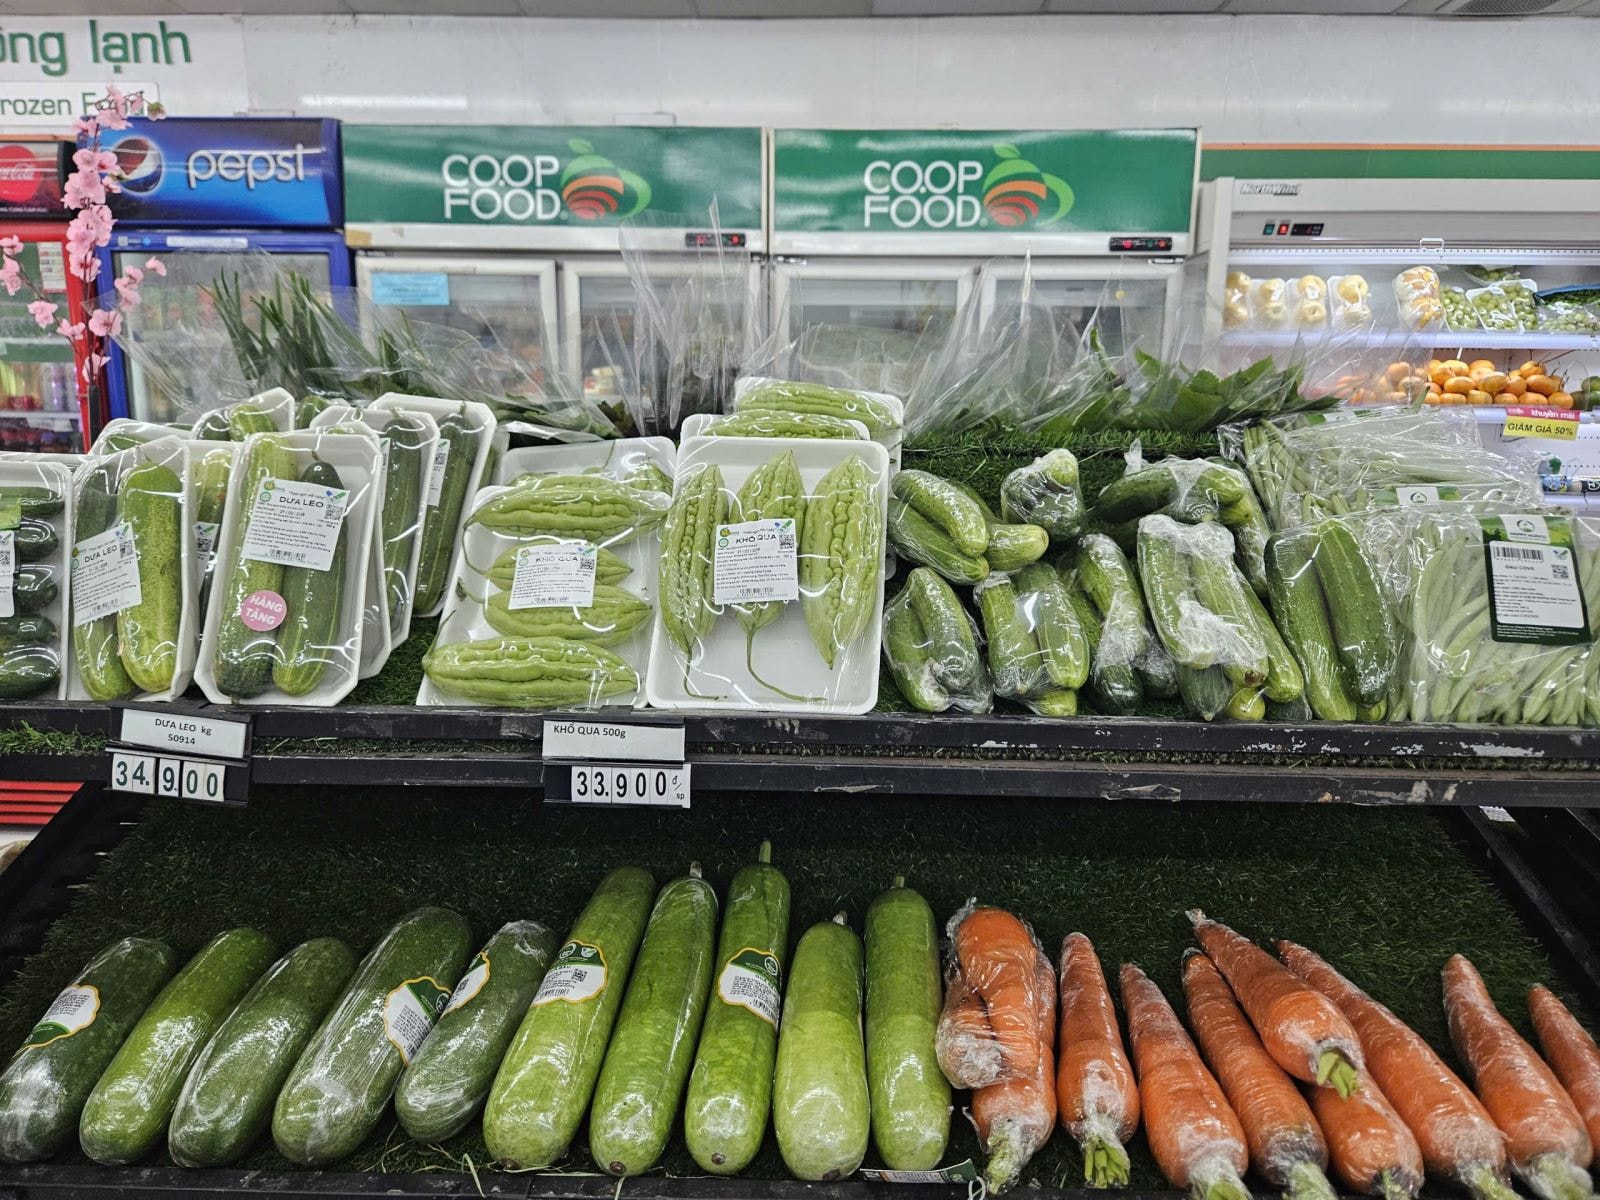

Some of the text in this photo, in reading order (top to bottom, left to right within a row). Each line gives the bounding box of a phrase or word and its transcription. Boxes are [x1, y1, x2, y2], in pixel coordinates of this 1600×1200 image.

[0, 19, 192, 77] ng lạnh
[188, 143, 305, 190] pepsi
[1535, 424, 1552, 434] GIÁ
[1554, 426, 1573, 436] 50%
[280, 496, 324, 508] DƯA LEO
[84, 545, 118, 563] DƯA LEO
[250, 595, 283, 613] HÀNG
[155, 718, 212, 736] DƯA LEO kg
[554, 722, 626, 739] KHỔ QUA 500g
[168, 734, 195, 744] 50914
[576, 771, 667, 798] 33.900
